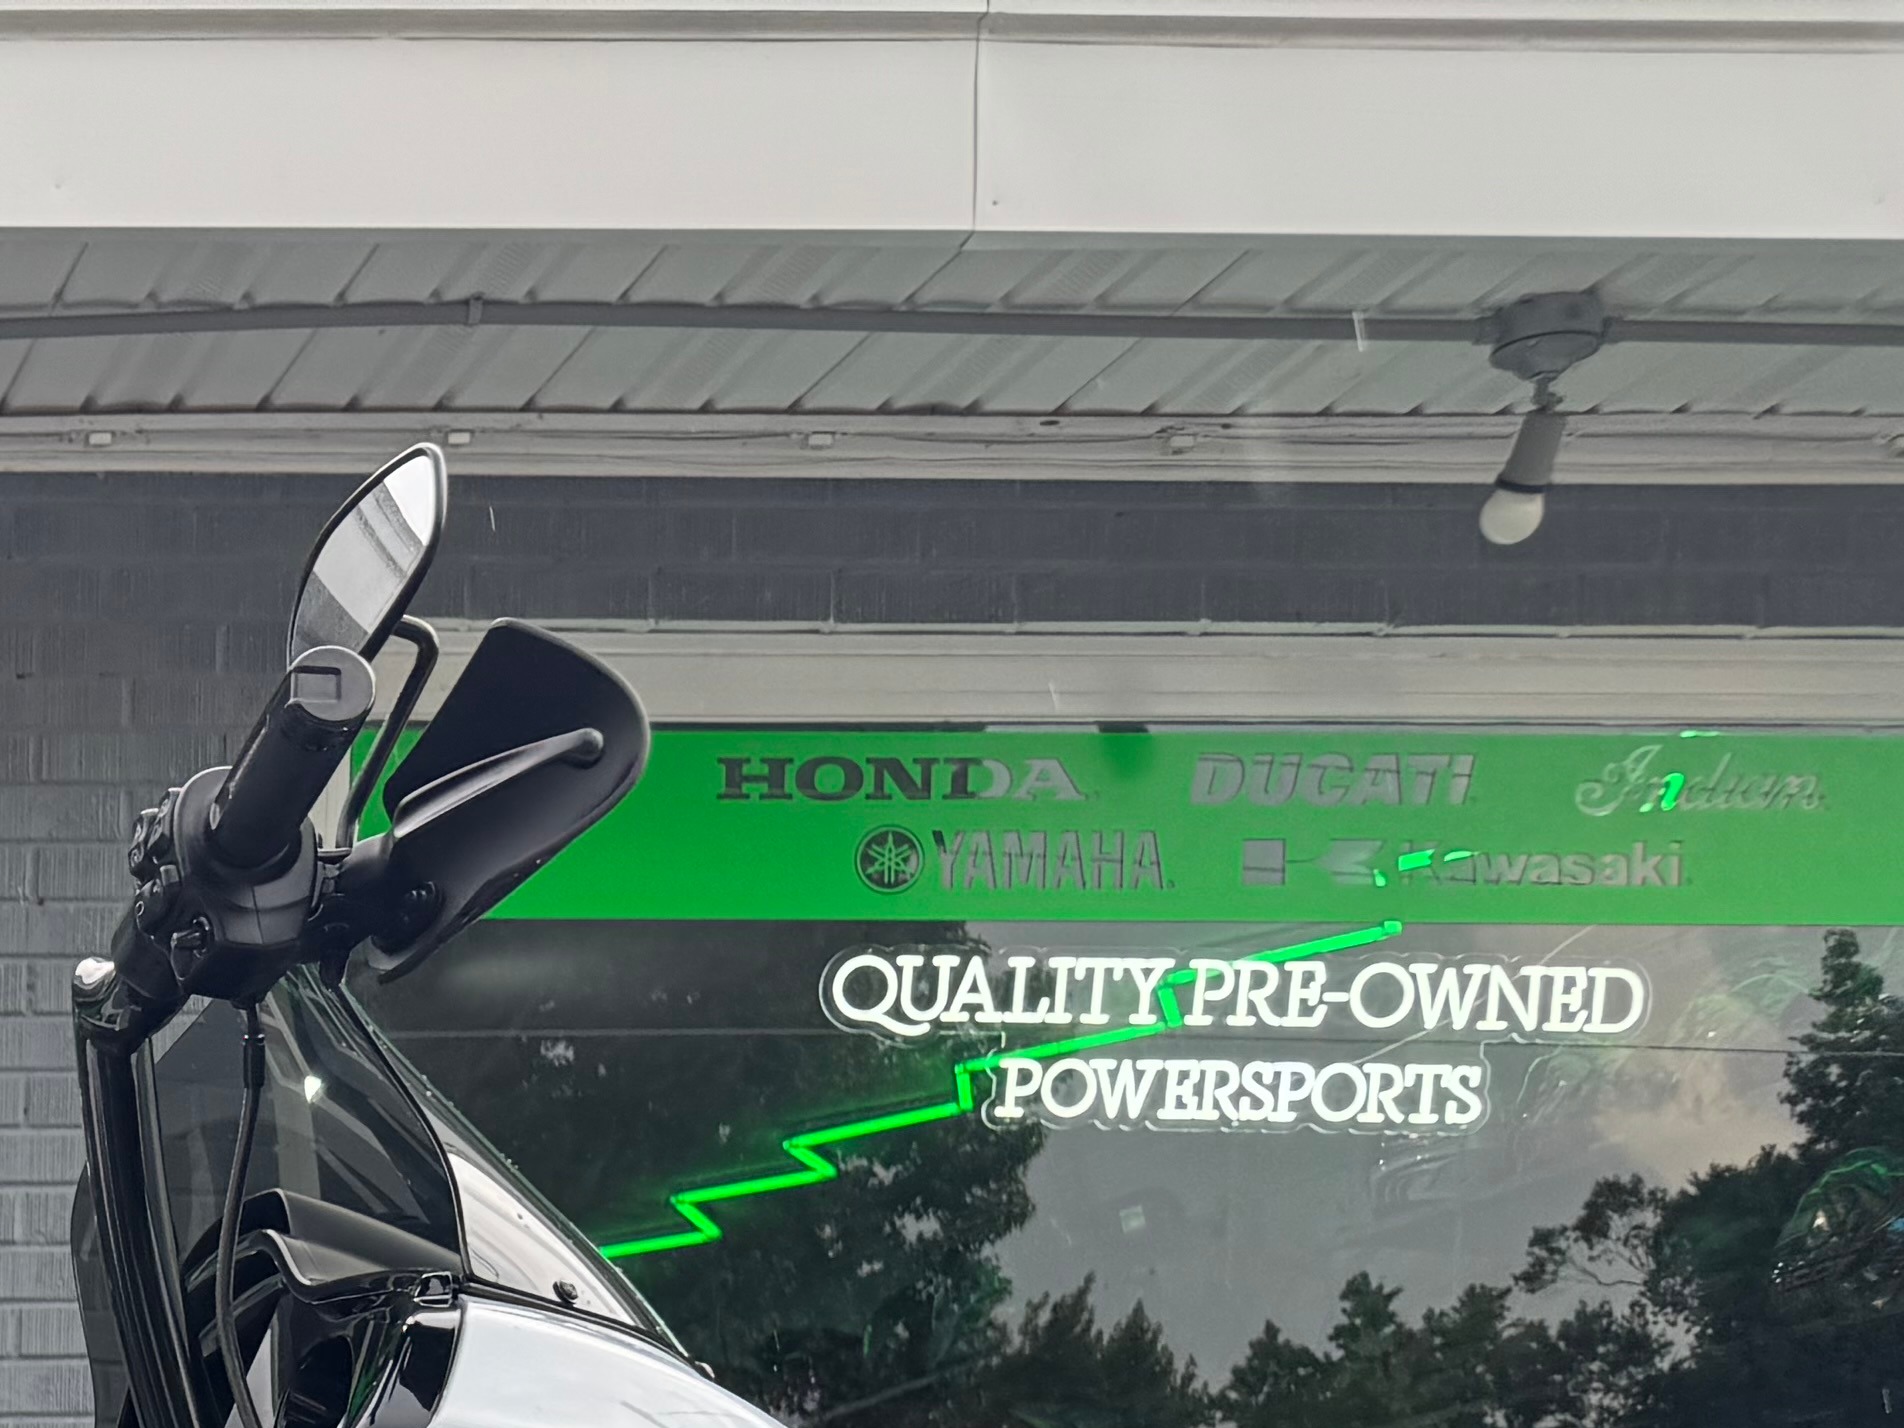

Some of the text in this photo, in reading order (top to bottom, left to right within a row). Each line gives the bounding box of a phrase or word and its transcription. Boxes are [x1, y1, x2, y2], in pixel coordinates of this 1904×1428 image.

[716, 757, 1090, 802] HONDA
[1192, 752, 1476, 806] DUCATI
[1575, 744, 1822, 816] Indian
[932, 830, 1166, 890] YAMAHA
[1399, 840, 1684, 886] Kawasaki
[830, 955, 1646, 1037] QUALITY PRE-OWNED
[994, 1057, 1484, 1126] POWERSPORTS
